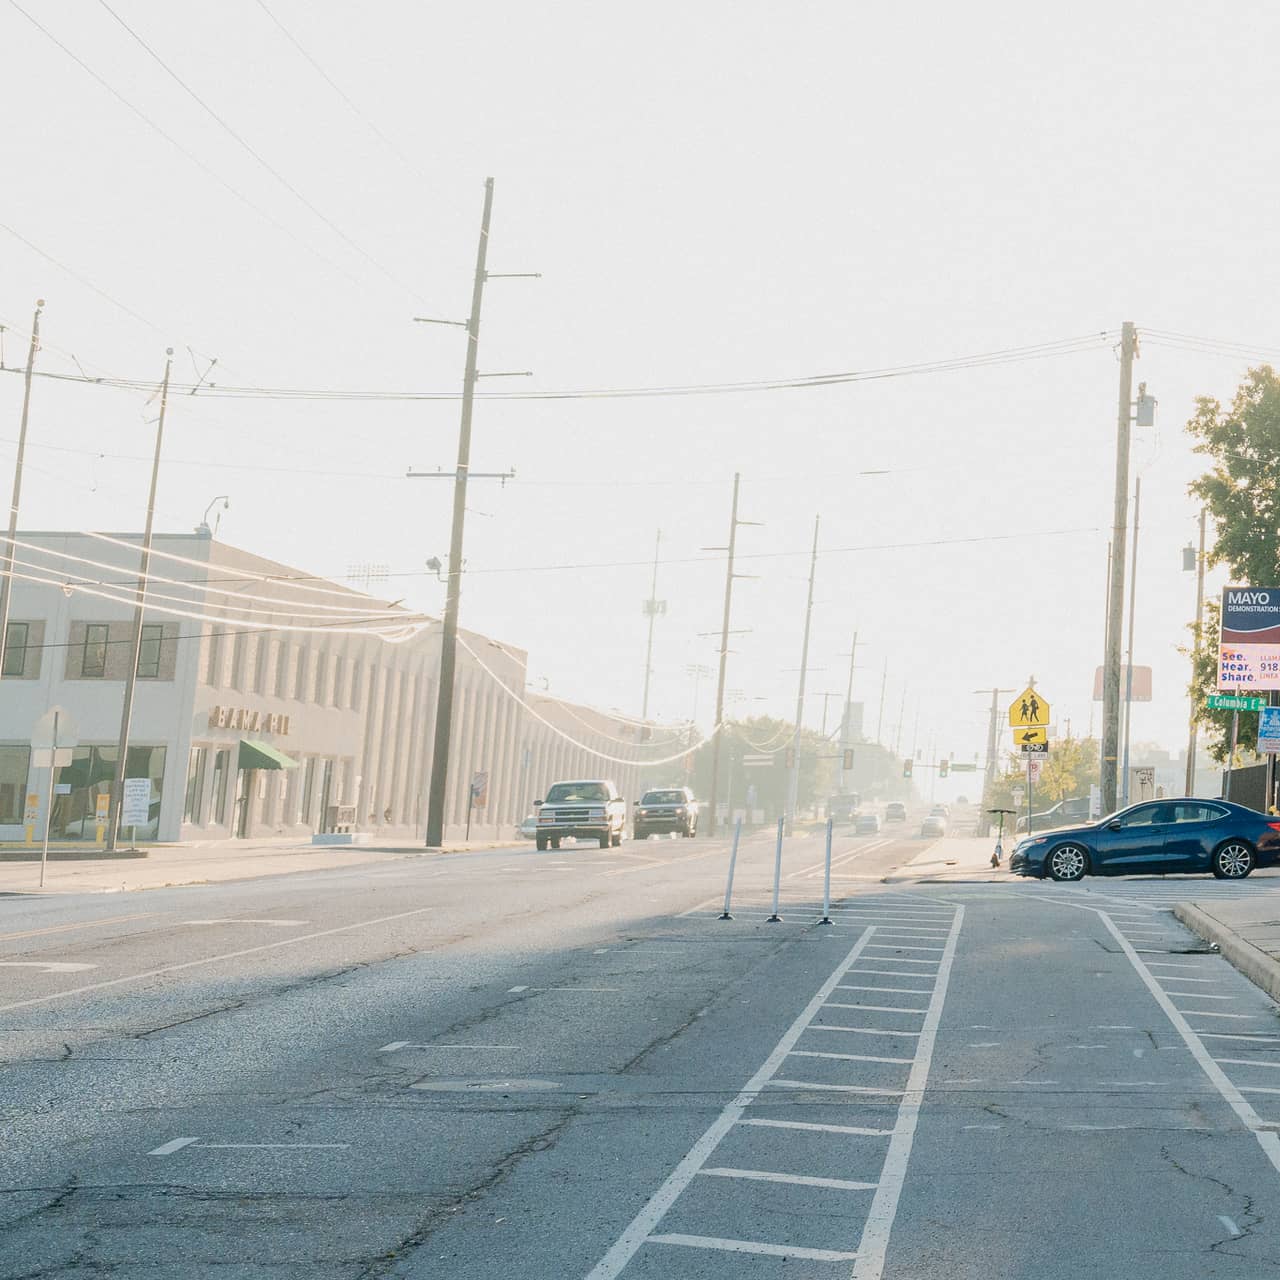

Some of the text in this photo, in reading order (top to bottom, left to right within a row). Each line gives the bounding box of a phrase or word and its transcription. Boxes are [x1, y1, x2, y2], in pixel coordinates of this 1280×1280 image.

[1228, 591, 1270, 605] MAYO
[1228, 605, 1278, 613] DEMONSTRATION
[1222, 652, 1246, 661] See.
[1222, 662, 1252, 671] Hear.
[1221, 672, 1257, 682] Share.
[1214, 697, 1248, 709] Columbia
